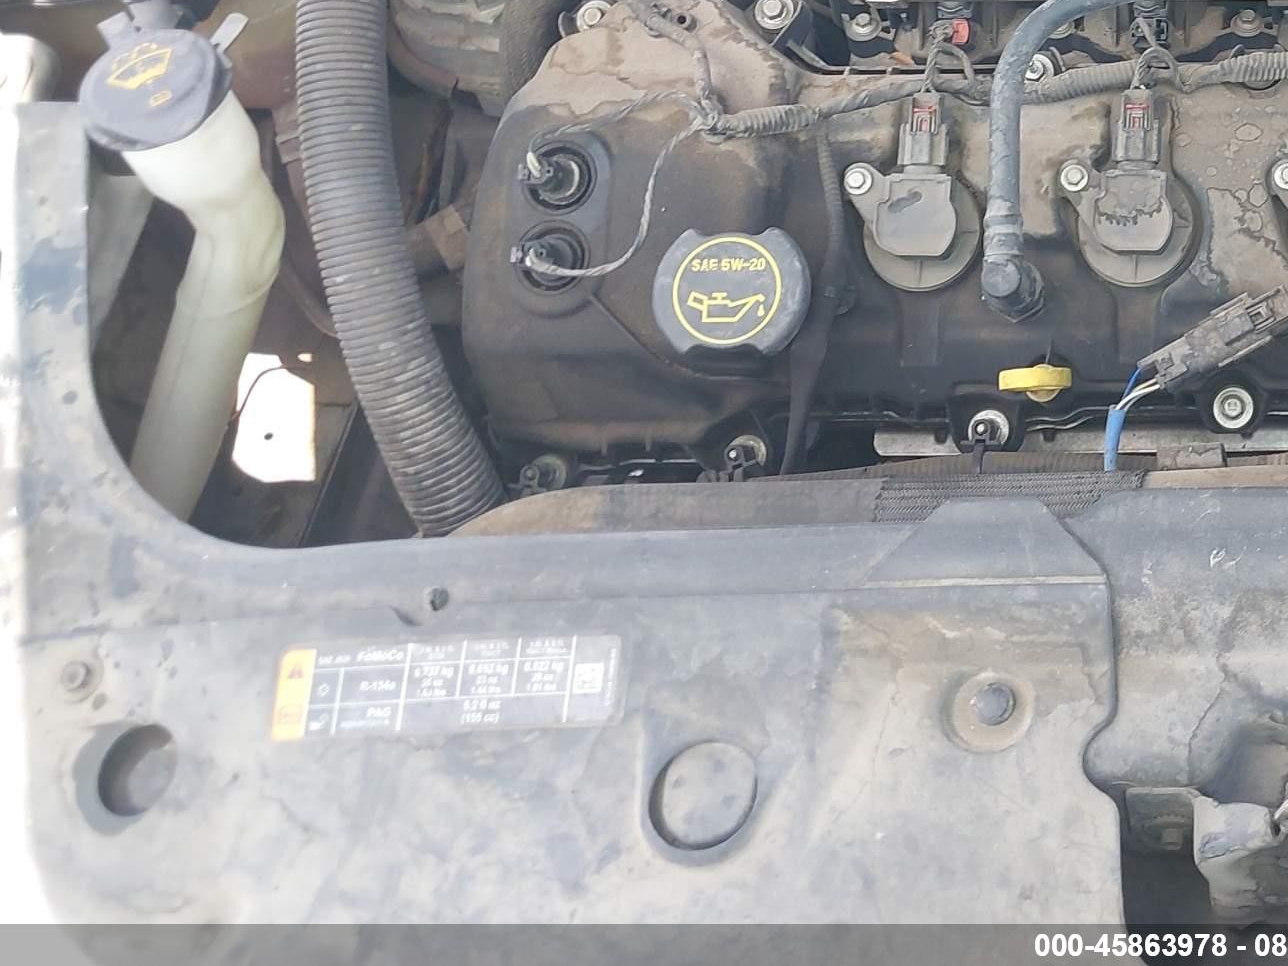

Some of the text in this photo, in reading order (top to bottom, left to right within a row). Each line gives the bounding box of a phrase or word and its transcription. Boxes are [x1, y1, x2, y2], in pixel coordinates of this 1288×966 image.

[691, 258, 766, 271] SAE 5W-20
[356, 648, 404, 662] FoMoCo
[440, 665, 454, 678] kg
[366, 706, 392, 717] PAG
[460, 712, 499, 724] (155 cc)
